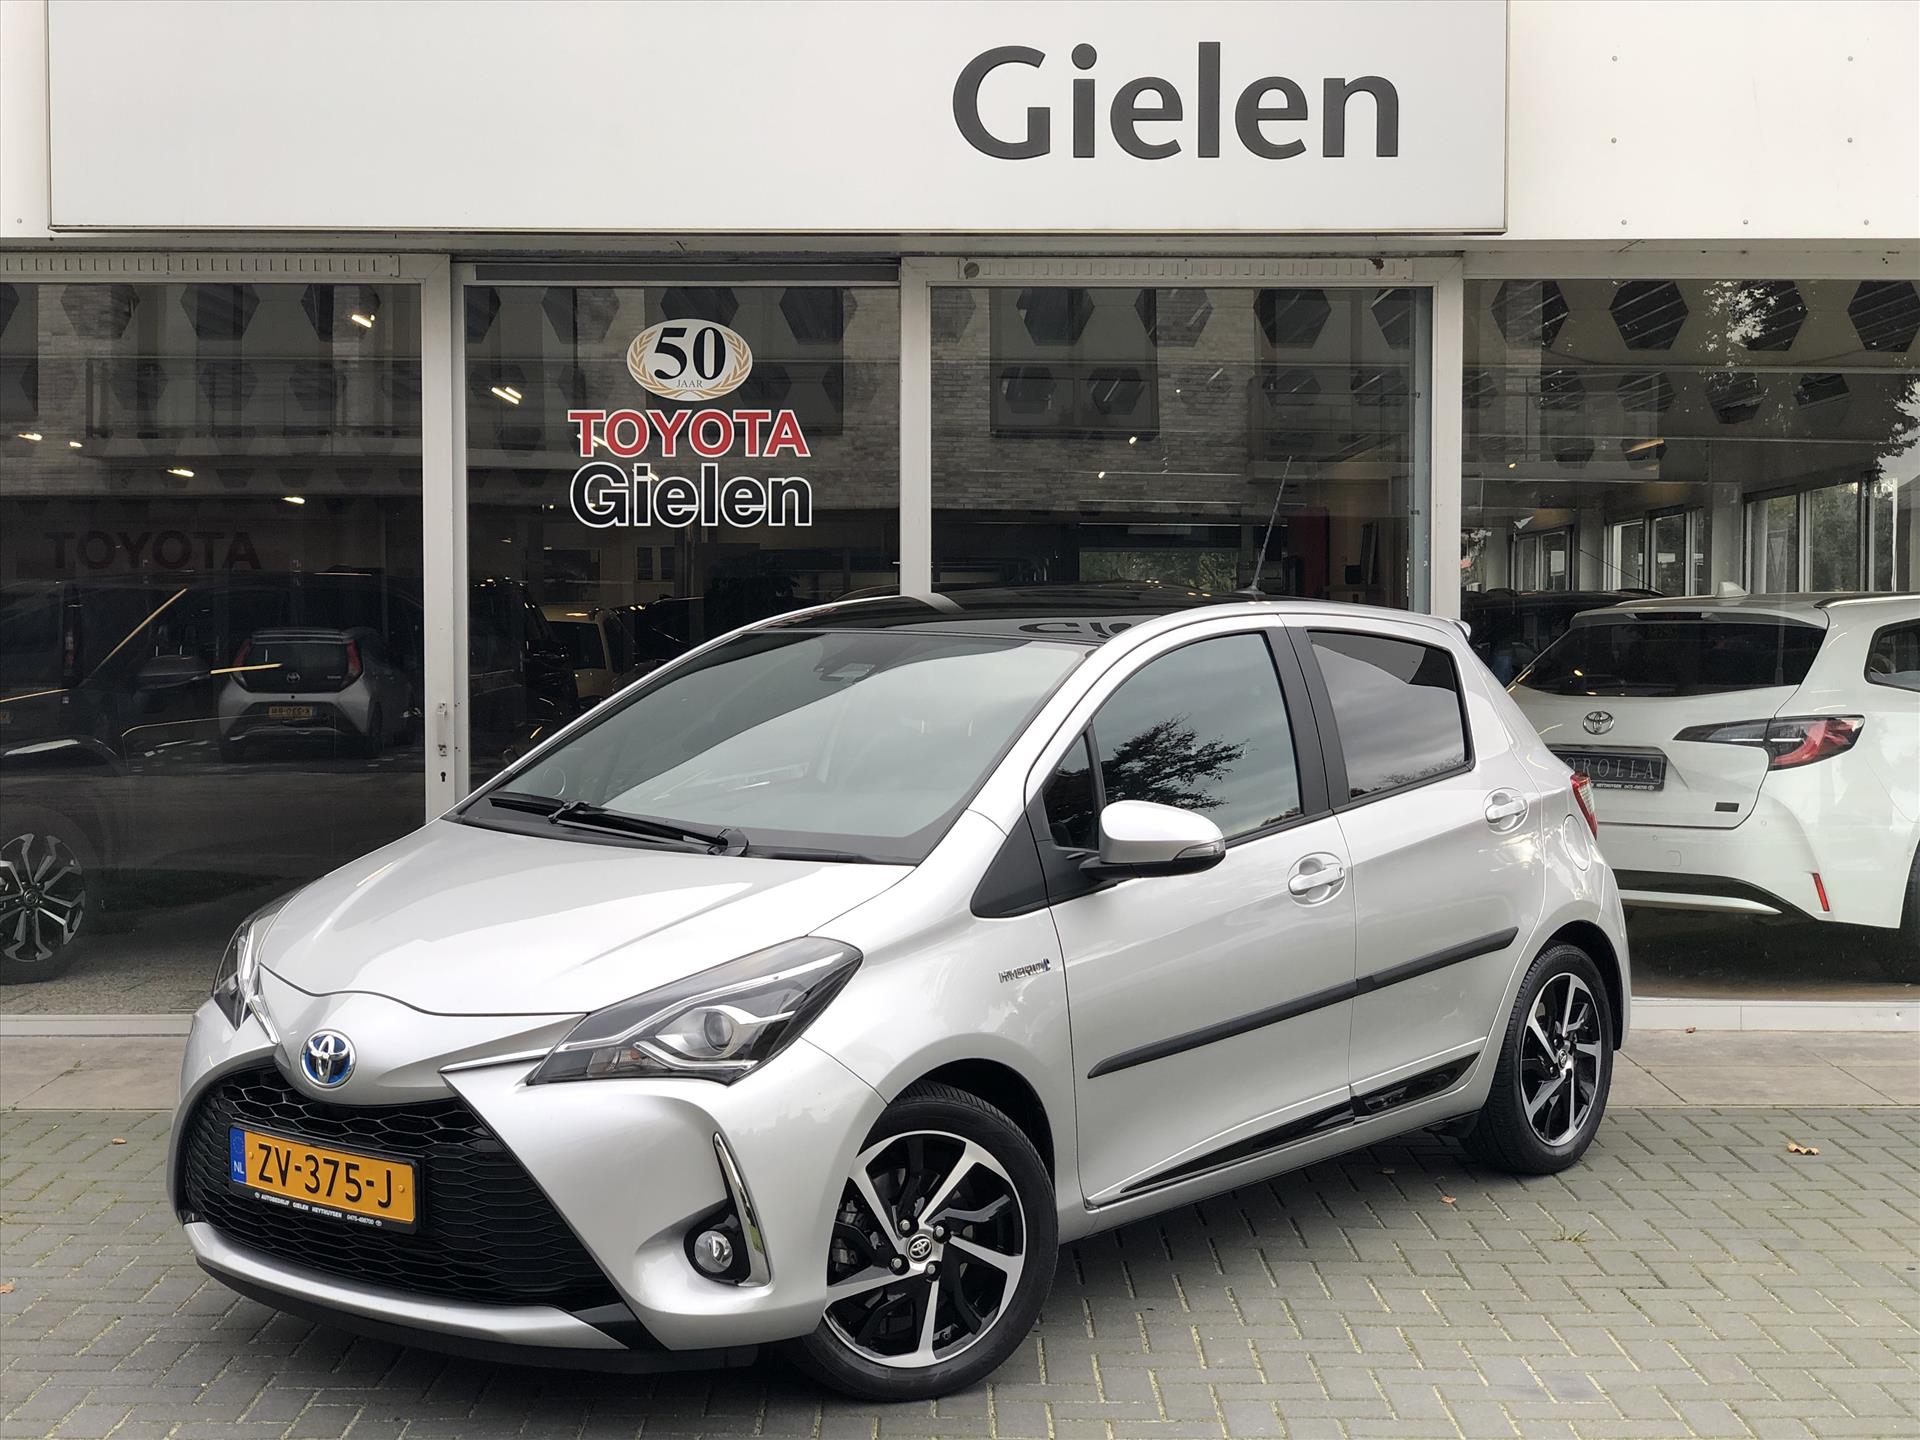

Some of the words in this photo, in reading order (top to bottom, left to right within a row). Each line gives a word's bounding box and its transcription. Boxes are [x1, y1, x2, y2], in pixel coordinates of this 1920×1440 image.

[952, 41, 1399, 160] Gielen
[653, 326, 727, 380] 50
[676, 379, 703, 388] JAAR
[567, 408, 812, 458] TOYOTA
[569, 461, 813, 528] Gielen
[44, 529, 262, 570] TOYOTA
[1564, 757, 1655, 779] OROLLA
[233, 1160, 245, 1175] NL
[257, 1142, 393, 1209] ZV-375-J
